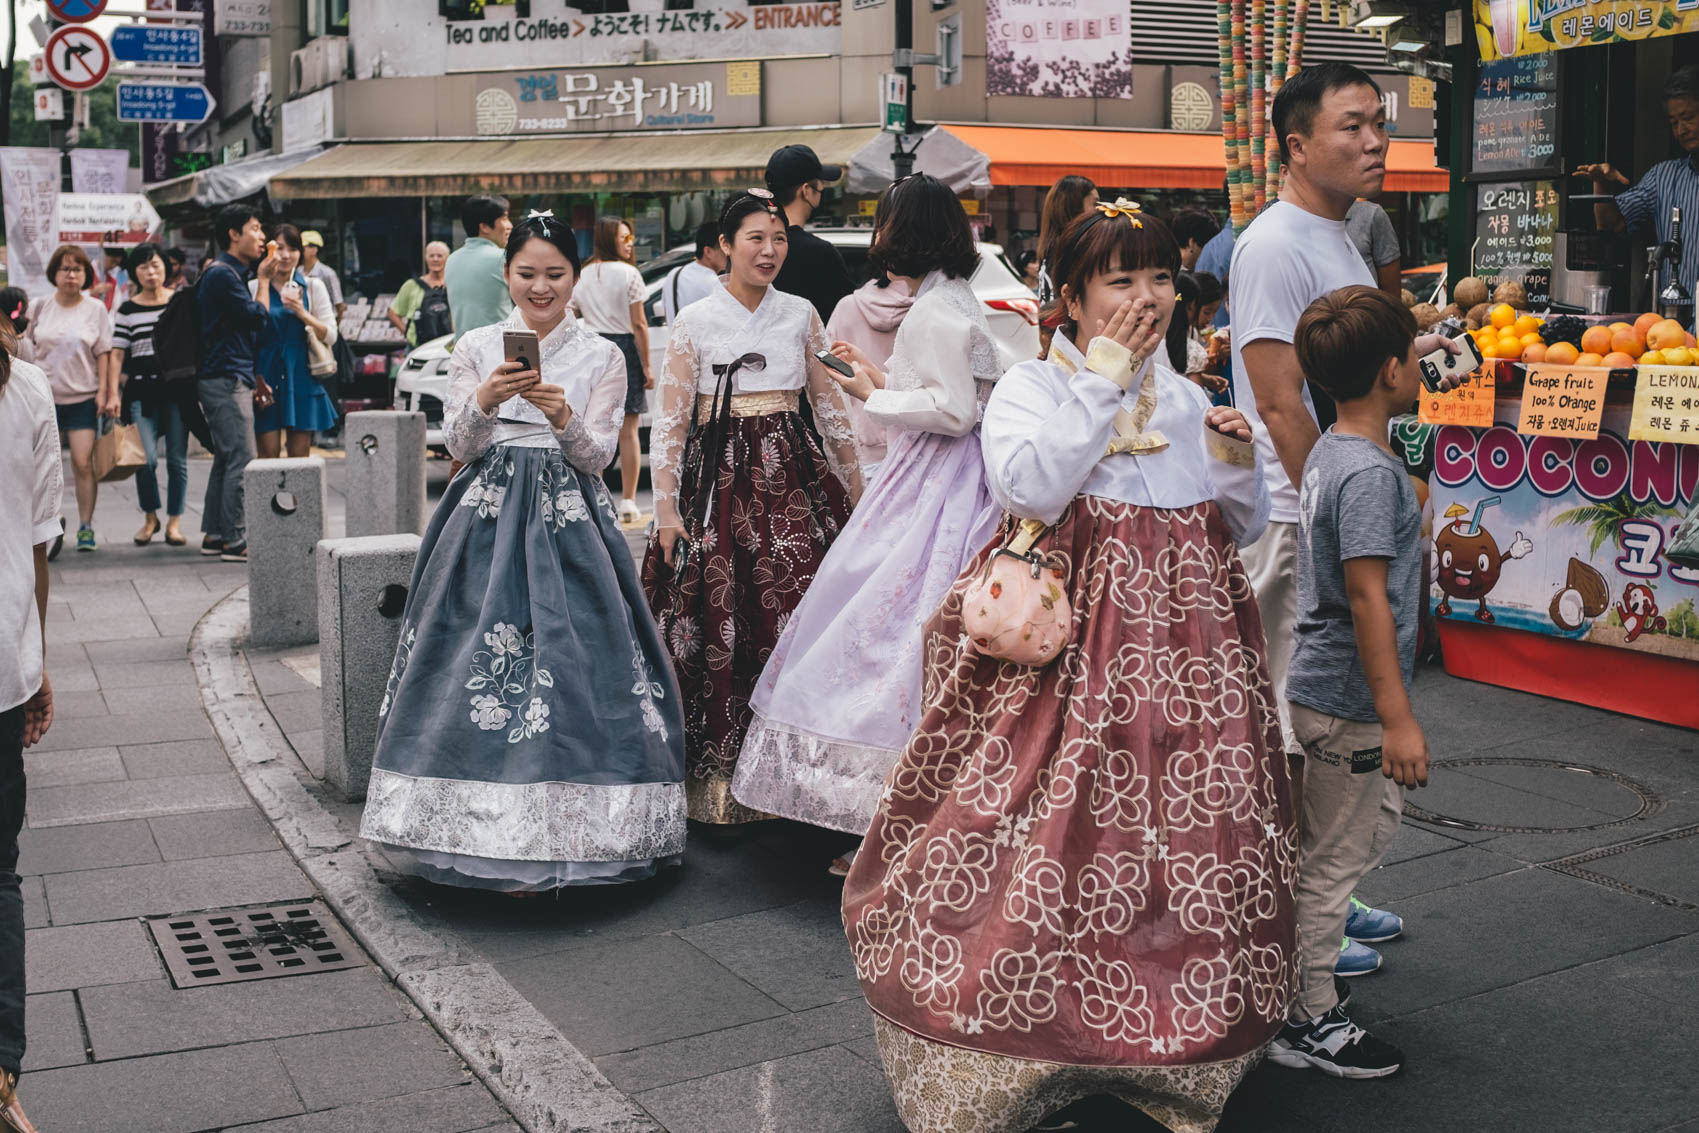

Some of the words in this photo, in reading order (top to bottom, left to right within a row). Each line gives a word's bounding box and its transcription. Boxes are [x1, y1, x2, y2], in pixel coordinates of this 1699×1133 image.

[446, 24, 473, 45] Tea
[479, 21, 510, 43] and
[515, 18, 570, 42] Coffee
[753, 5, 841, 30] ENTRANCE
[1001, 18, 1117, 39] COFFEE
[1562, 9, 1653, 37] 레몬에이드
[1481, 189, 1531, 212] 오렌지
[1487, 214, 1510, 235] 자몽
[1516, 212, 1554, 232] 바나나
[1529, 370, 1560, 391] Grape
[1564, 373, 1594, 390] fruit
[1649, 373, 1699, 389] LEMON
[1532, 395, 1555, 408] 100%
[1559, 395, 1597, 413] Orange
[1651, 395, 1675, 411] 레몬
[1650, 416, 1673, 431] 레몬
